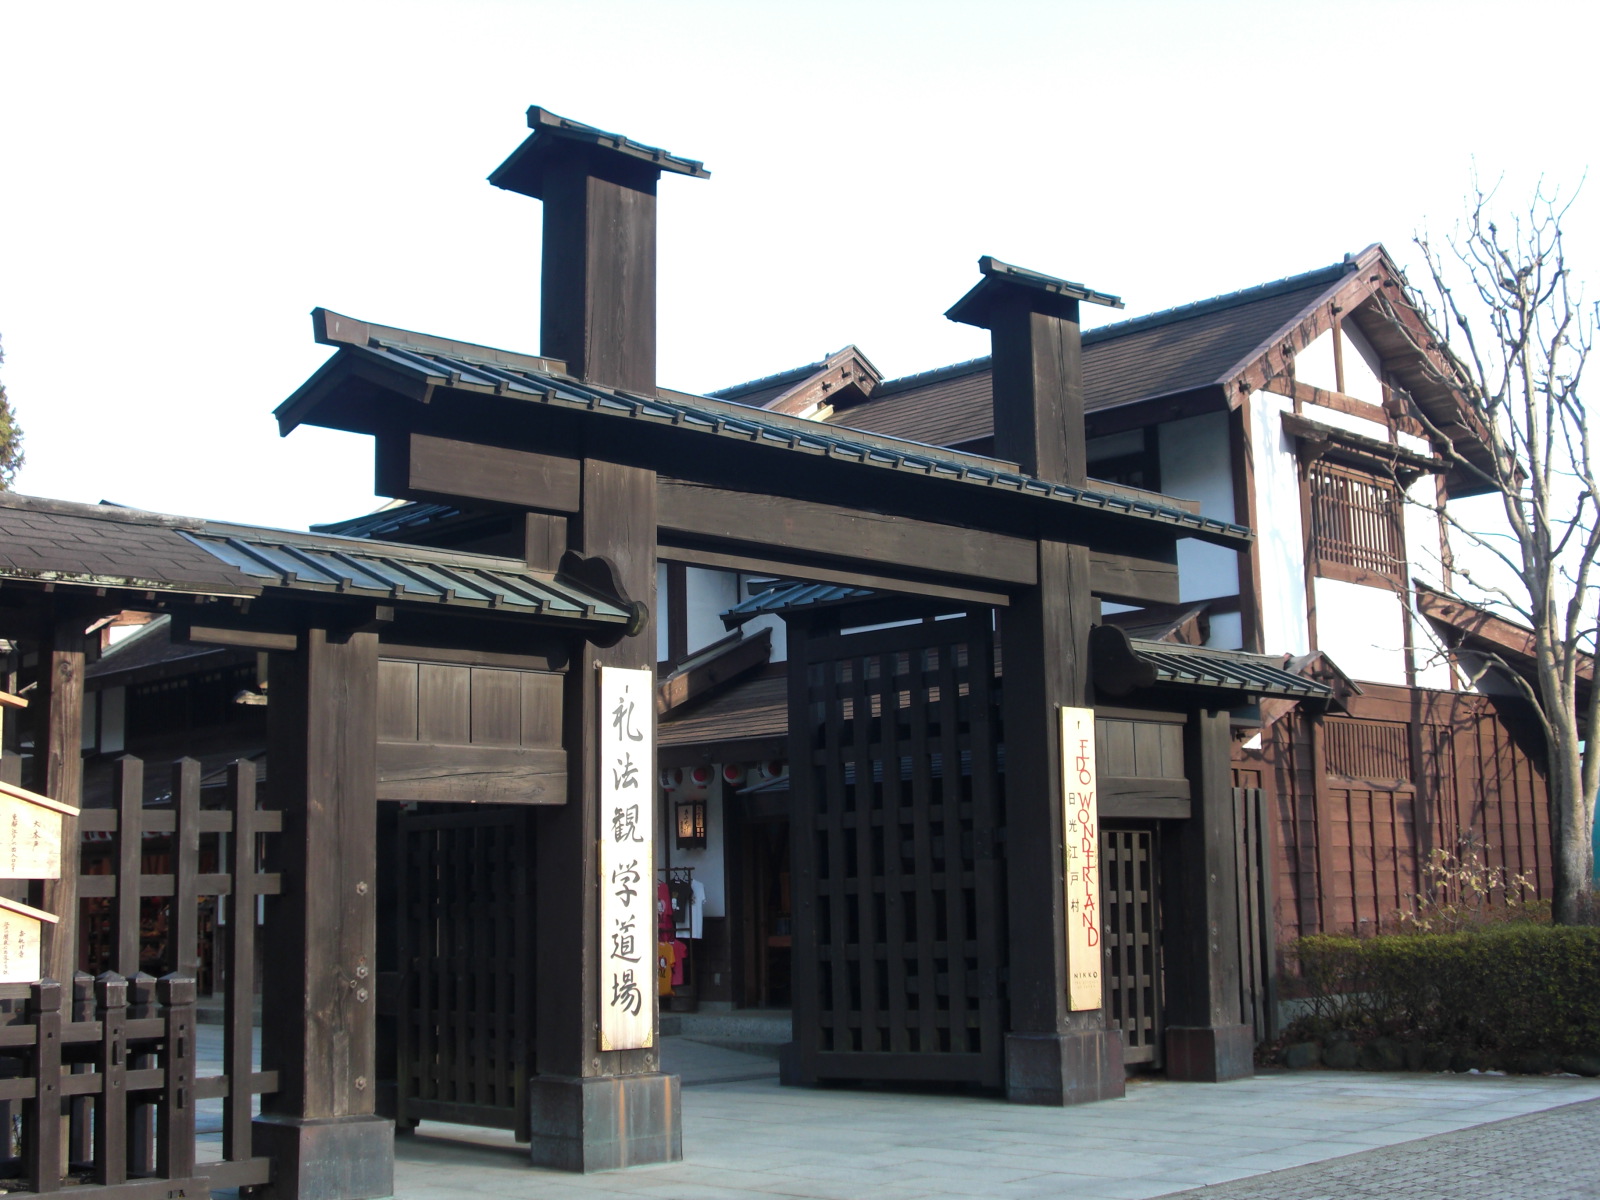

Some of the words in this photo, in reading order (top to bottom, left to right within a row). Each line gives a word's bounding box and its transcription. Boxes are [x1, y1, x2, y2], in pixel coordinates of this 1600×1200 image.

[1076, 739, 1092, 785] EDO
[611, 697, 644, 1017] 礼法観学道場
[1068, 792, 1079, 912] 日光江戸村
[1077, 792, 1099, 947] WONDERLAND
[1074, 971, 1098, 979] NIKKO
